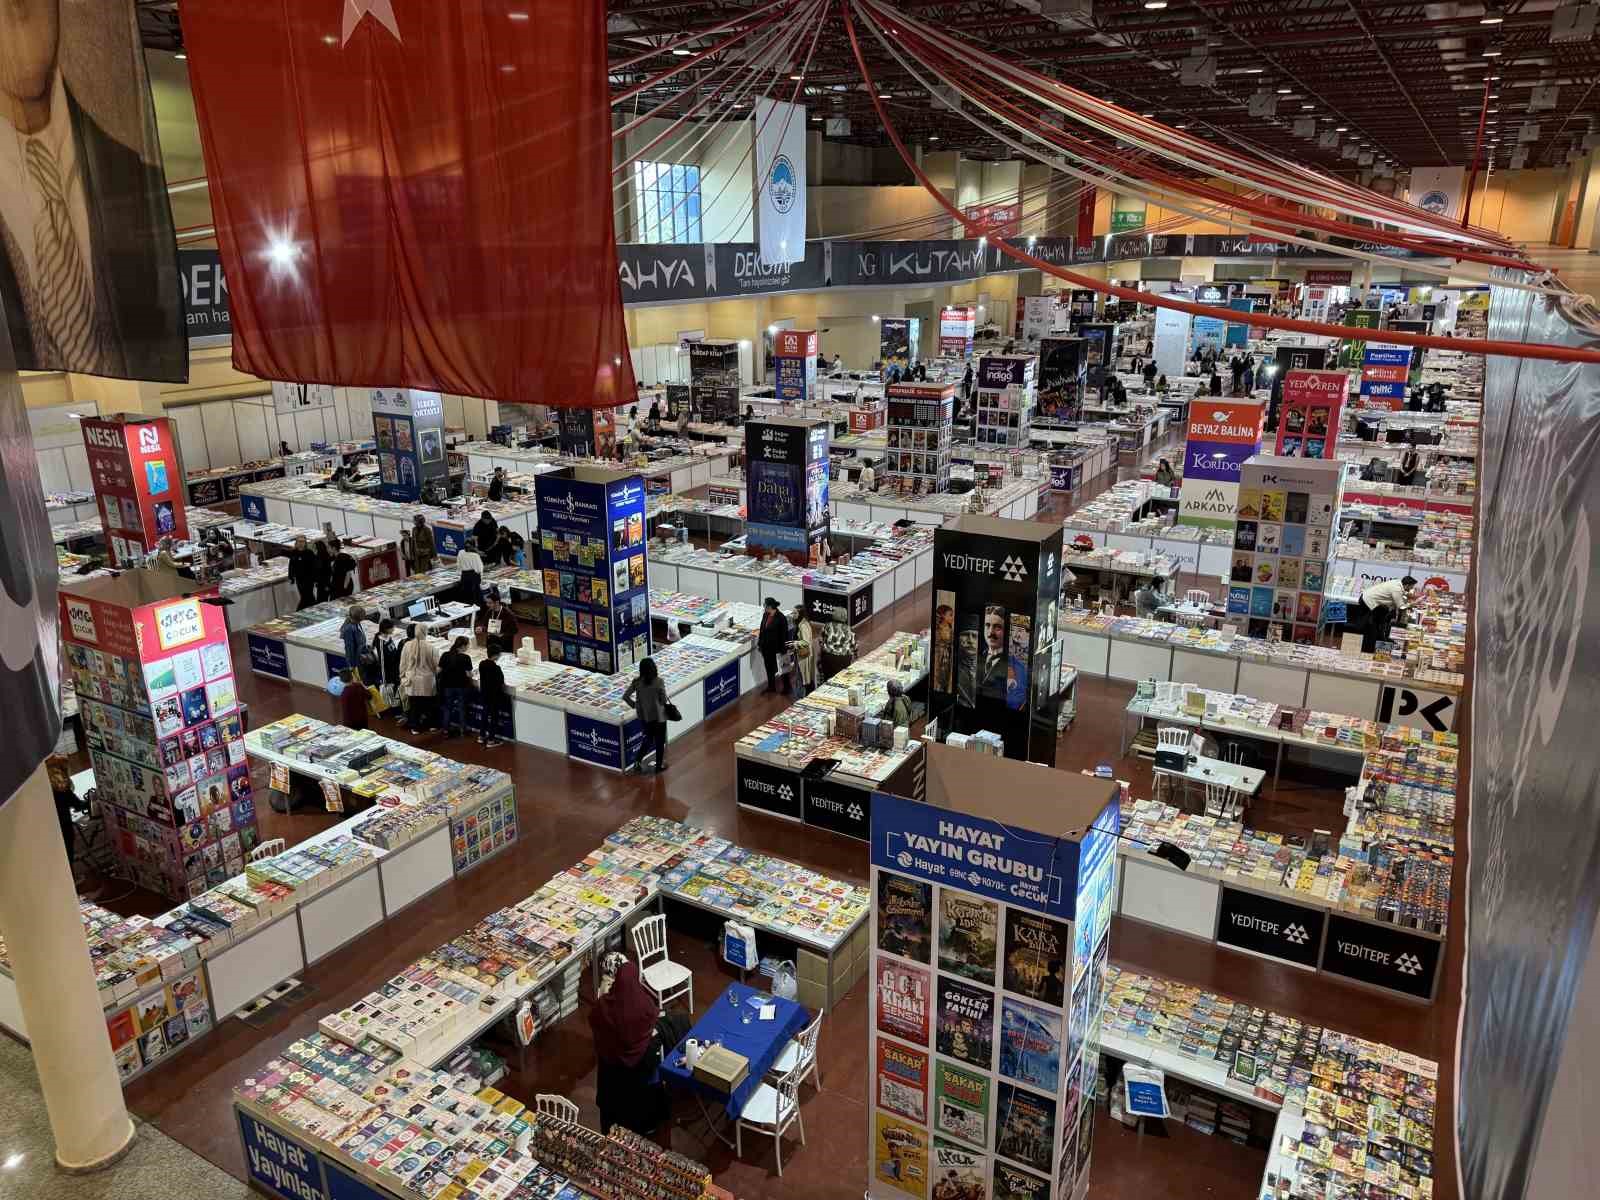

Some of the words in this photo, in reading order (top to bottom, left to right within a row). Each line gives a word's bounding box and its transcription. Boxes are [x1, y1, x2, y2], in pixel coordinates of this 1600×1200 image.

[1190, 423, 1220, 436] BEYAZ
[943, 552, 996, 575] YEDİTEPE
[1378, 686, 1454, 733] PK
[743, 777, 775, 795] YEDİTEPE
[810, 795, 844, 814] YEDİTEPE
[939, 820, 1005, 851] HAYAT
[904, 831, 963, 861] YAYIN
[967, 849, 1044, 882] GRUBU
[914, 857, 946, 875] Hayat
[1230, 912, 1281, 936] YEDİTEPE
[1336, 940, 1391, 966] YEDİTEPE
[944, 990, 990, 1012] GÖKLER
[254, 1120, 309, 1173] Hayat
